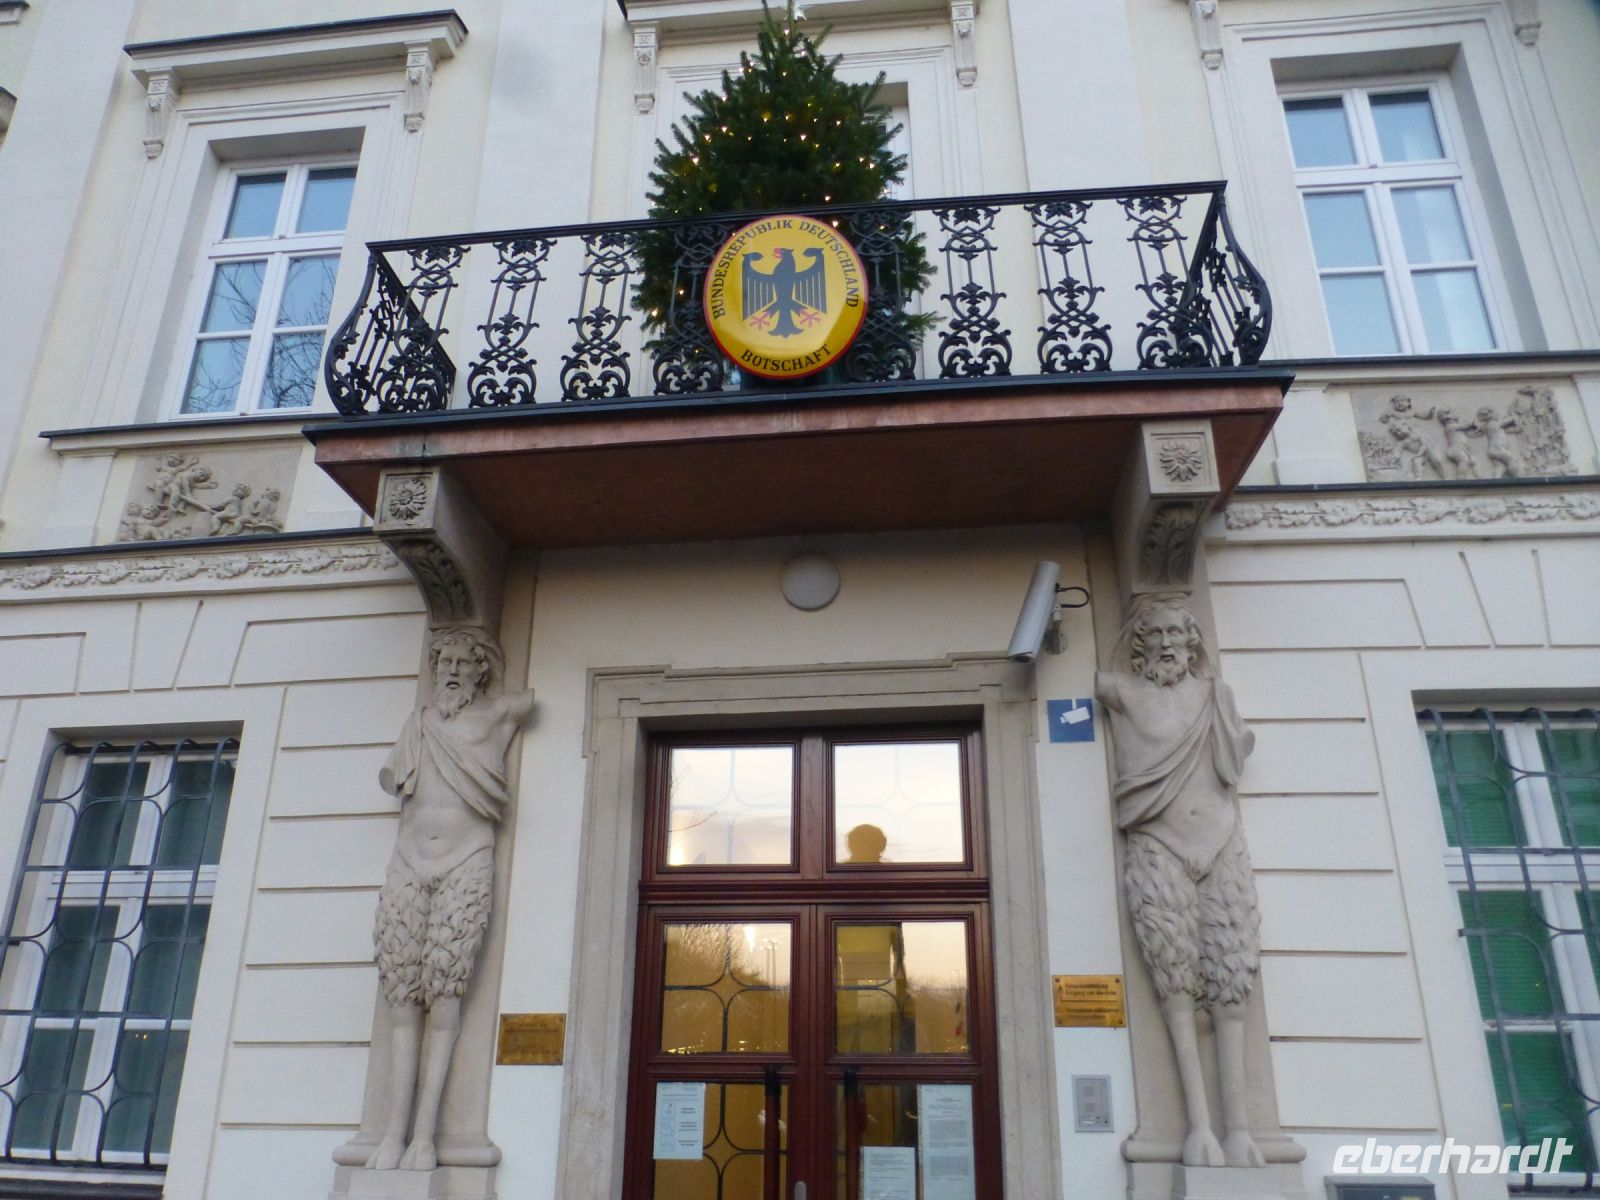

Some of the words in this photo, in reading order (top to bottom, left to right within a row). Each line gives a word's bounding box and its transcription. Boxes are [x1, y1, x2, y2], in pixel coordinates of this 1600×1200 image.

[710, 219, 793, 320] BUNDESREPUBLIK
[798, 221, 860, 308] DEUTSCHLAND
[741, 343, 833, 372] BOTSCHAFT
